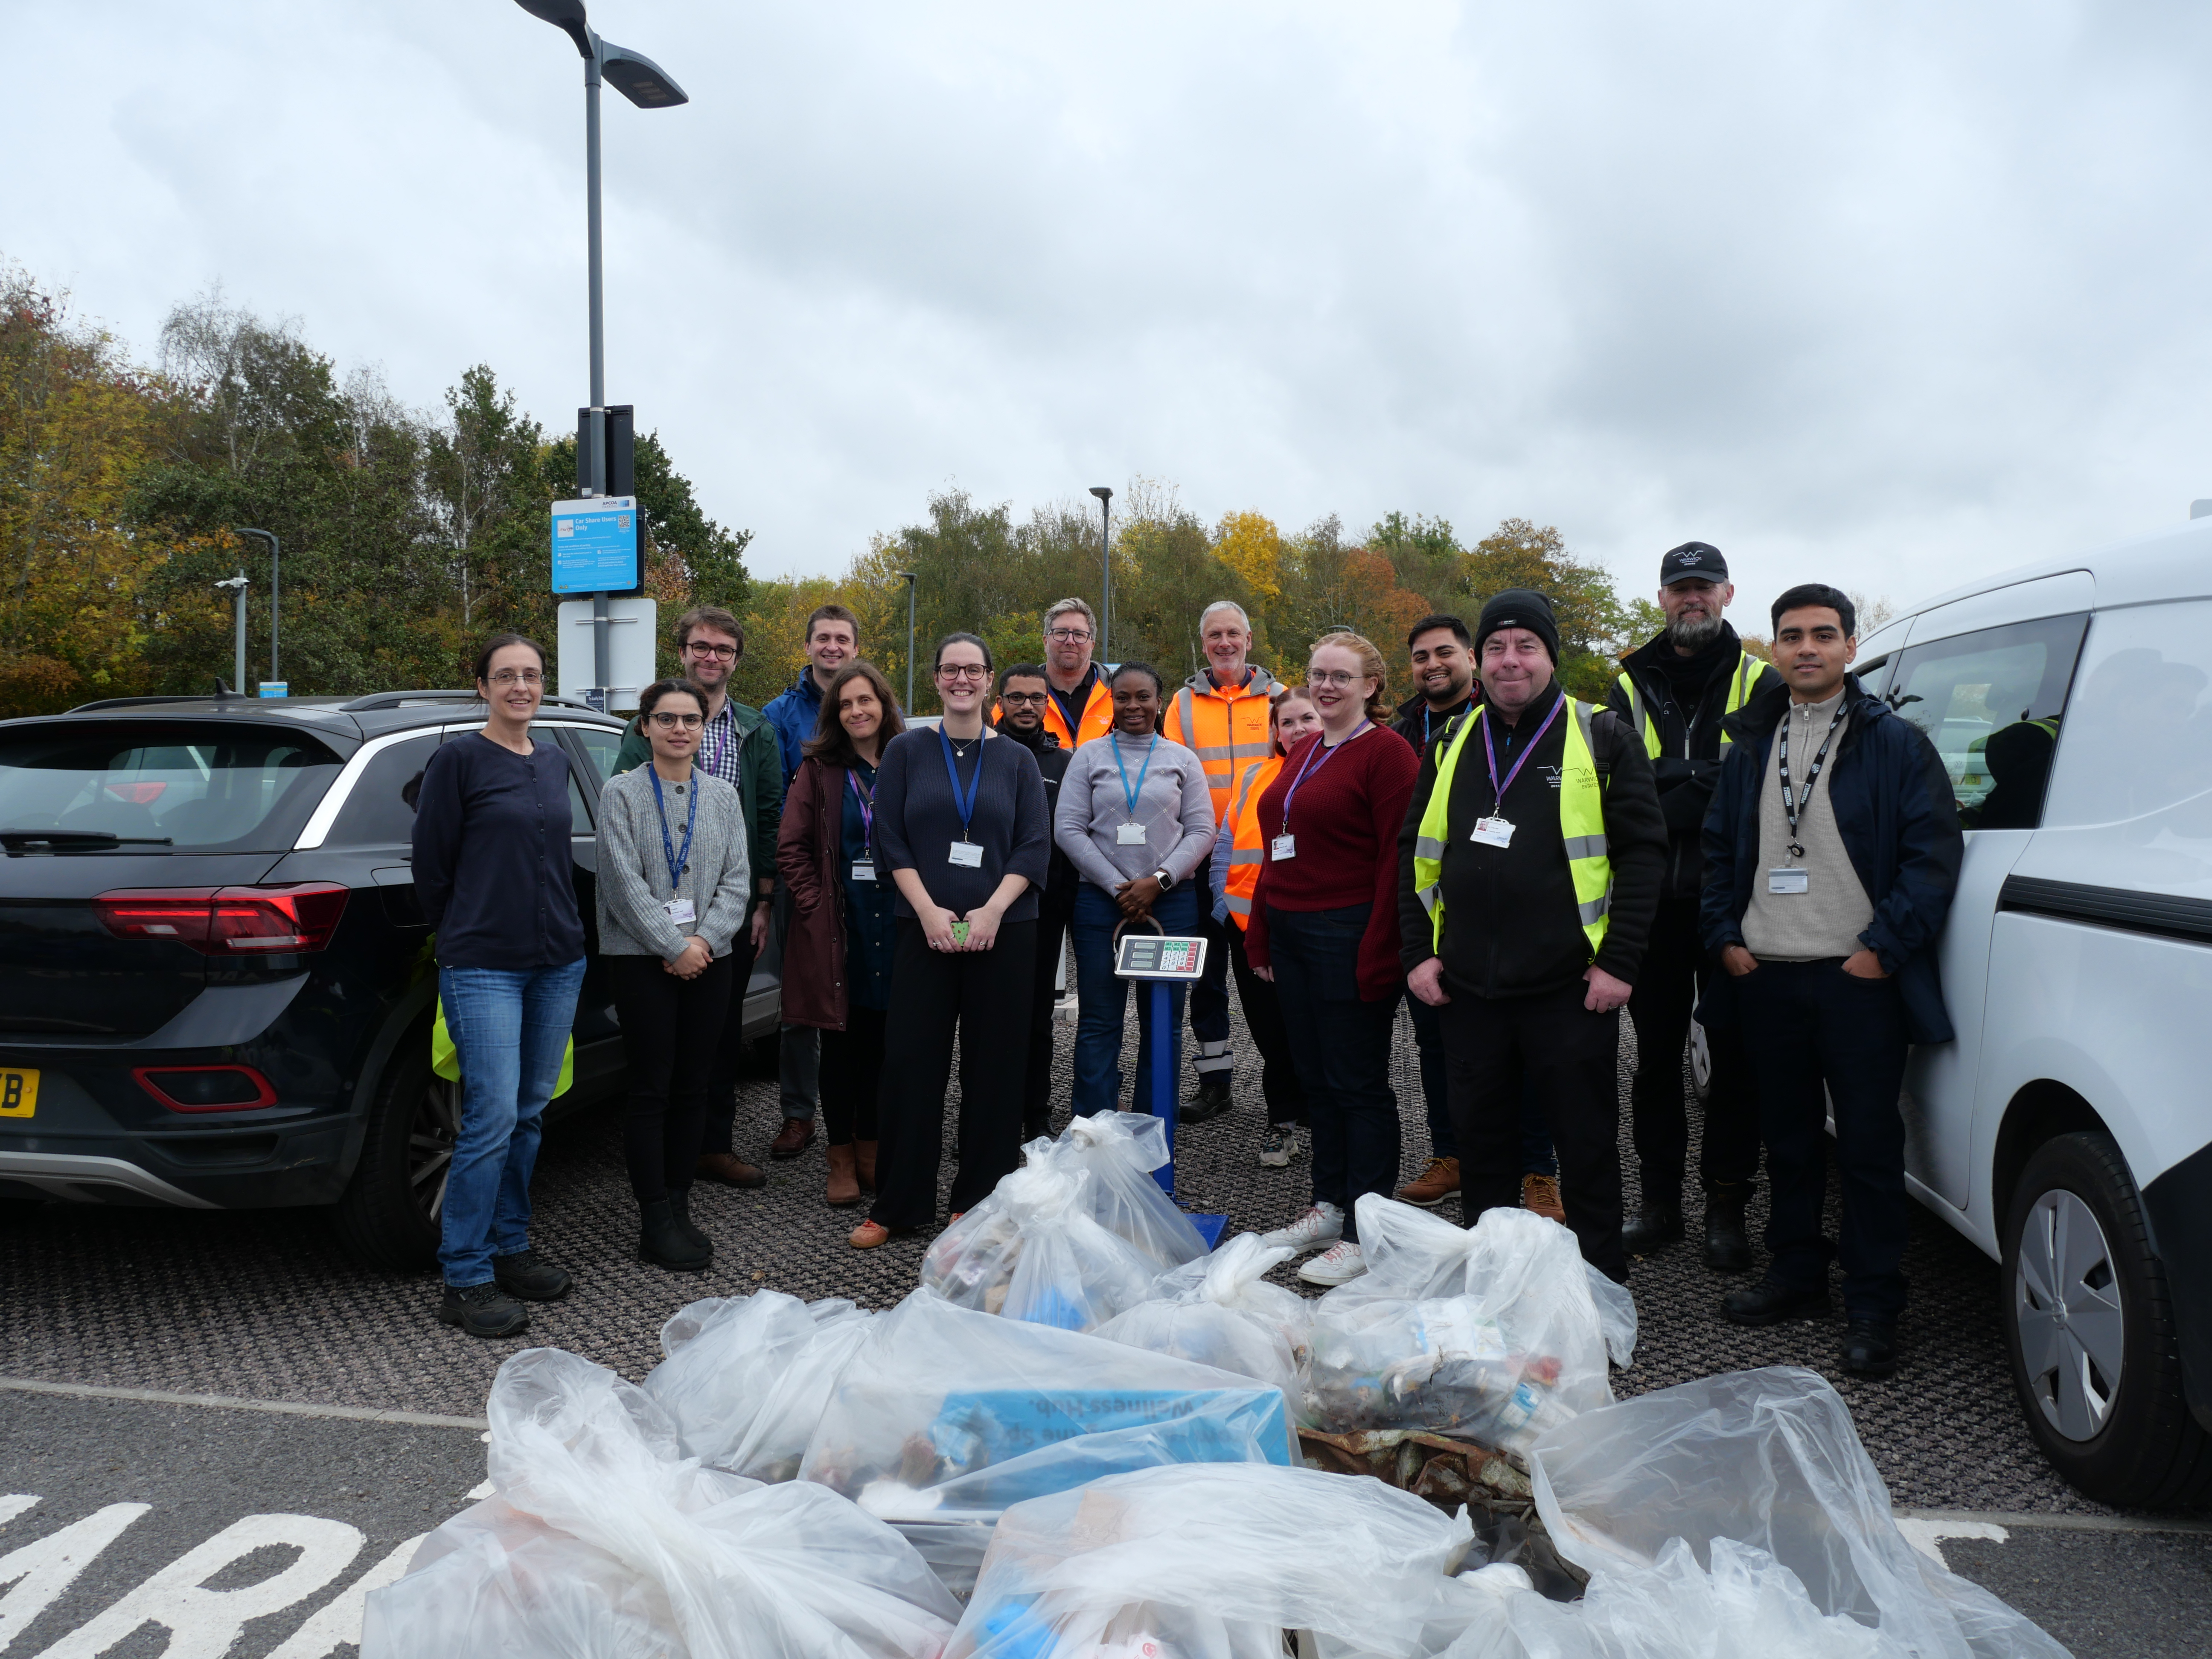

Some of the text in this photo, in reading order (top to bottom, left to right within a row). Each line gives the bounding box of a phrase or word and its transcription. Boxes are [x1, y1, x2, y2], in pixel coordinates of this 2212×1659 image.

[0, 1073, 23, 1109] B
[1028, 1397, 1193, 1419] Wellness Hub.
